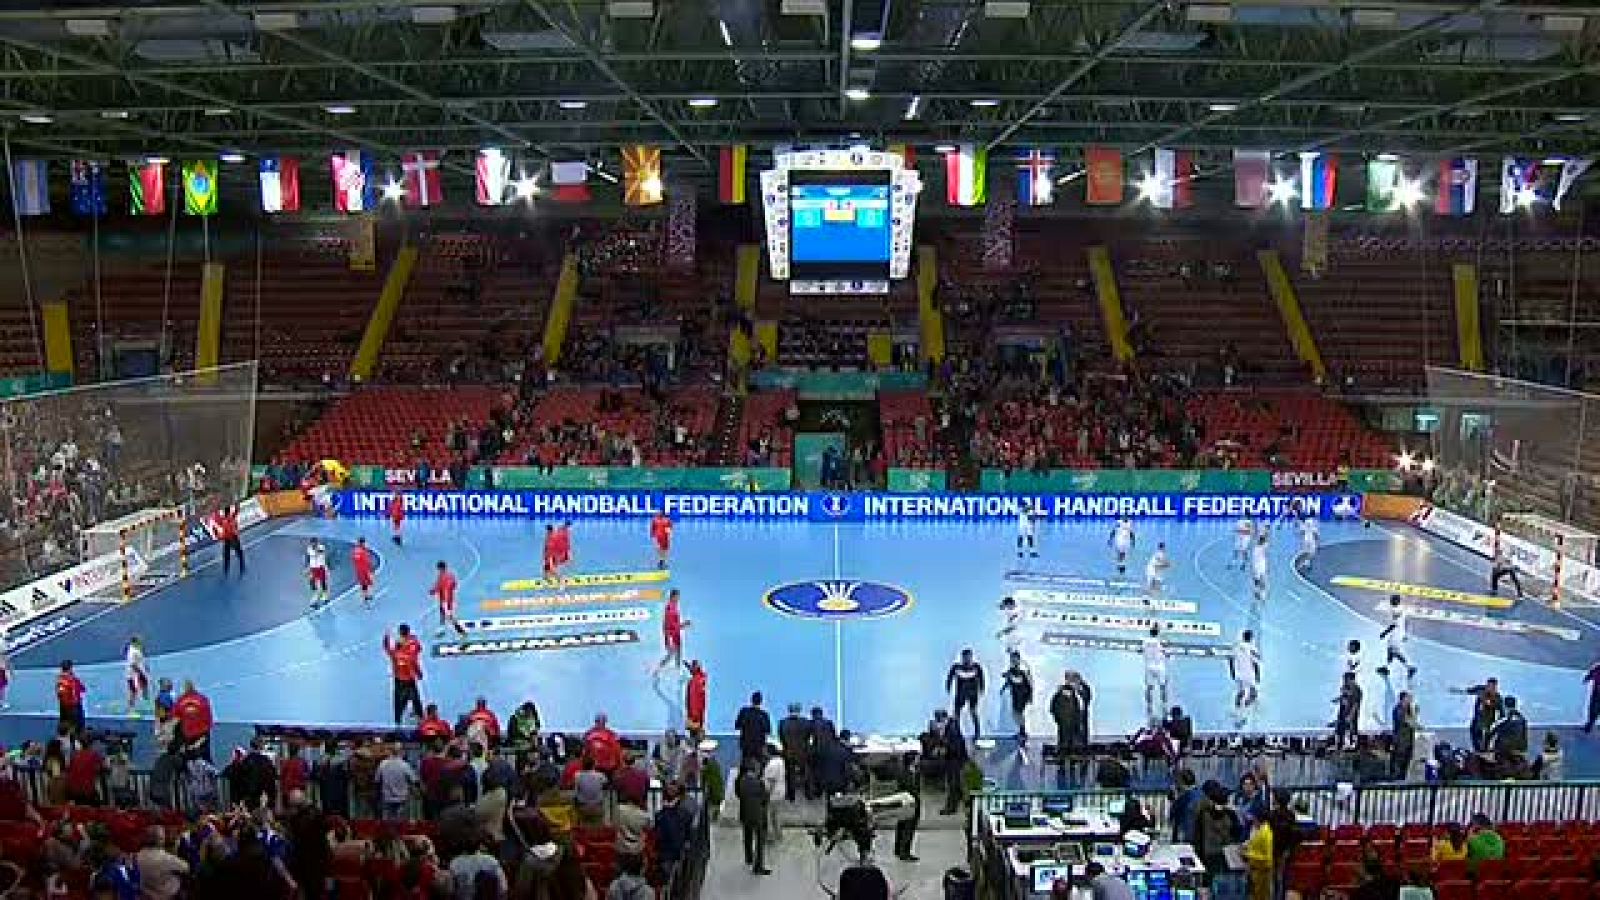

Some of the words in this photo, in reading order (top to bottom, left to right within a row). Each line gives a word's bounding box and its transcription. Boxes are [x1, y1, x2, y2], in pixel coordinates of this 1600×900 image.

[384, 469, 451, 482] SEVLA
[353, 494, 529, 514] INTRNATIONAL
[534, 494, 660, 514] HANDBALL
[664, 494, 808, 514] FEDERATION
[1054, 495, 1178, 516] HANDBALL
[1184, 496, 1321, 516] FEDERATON
